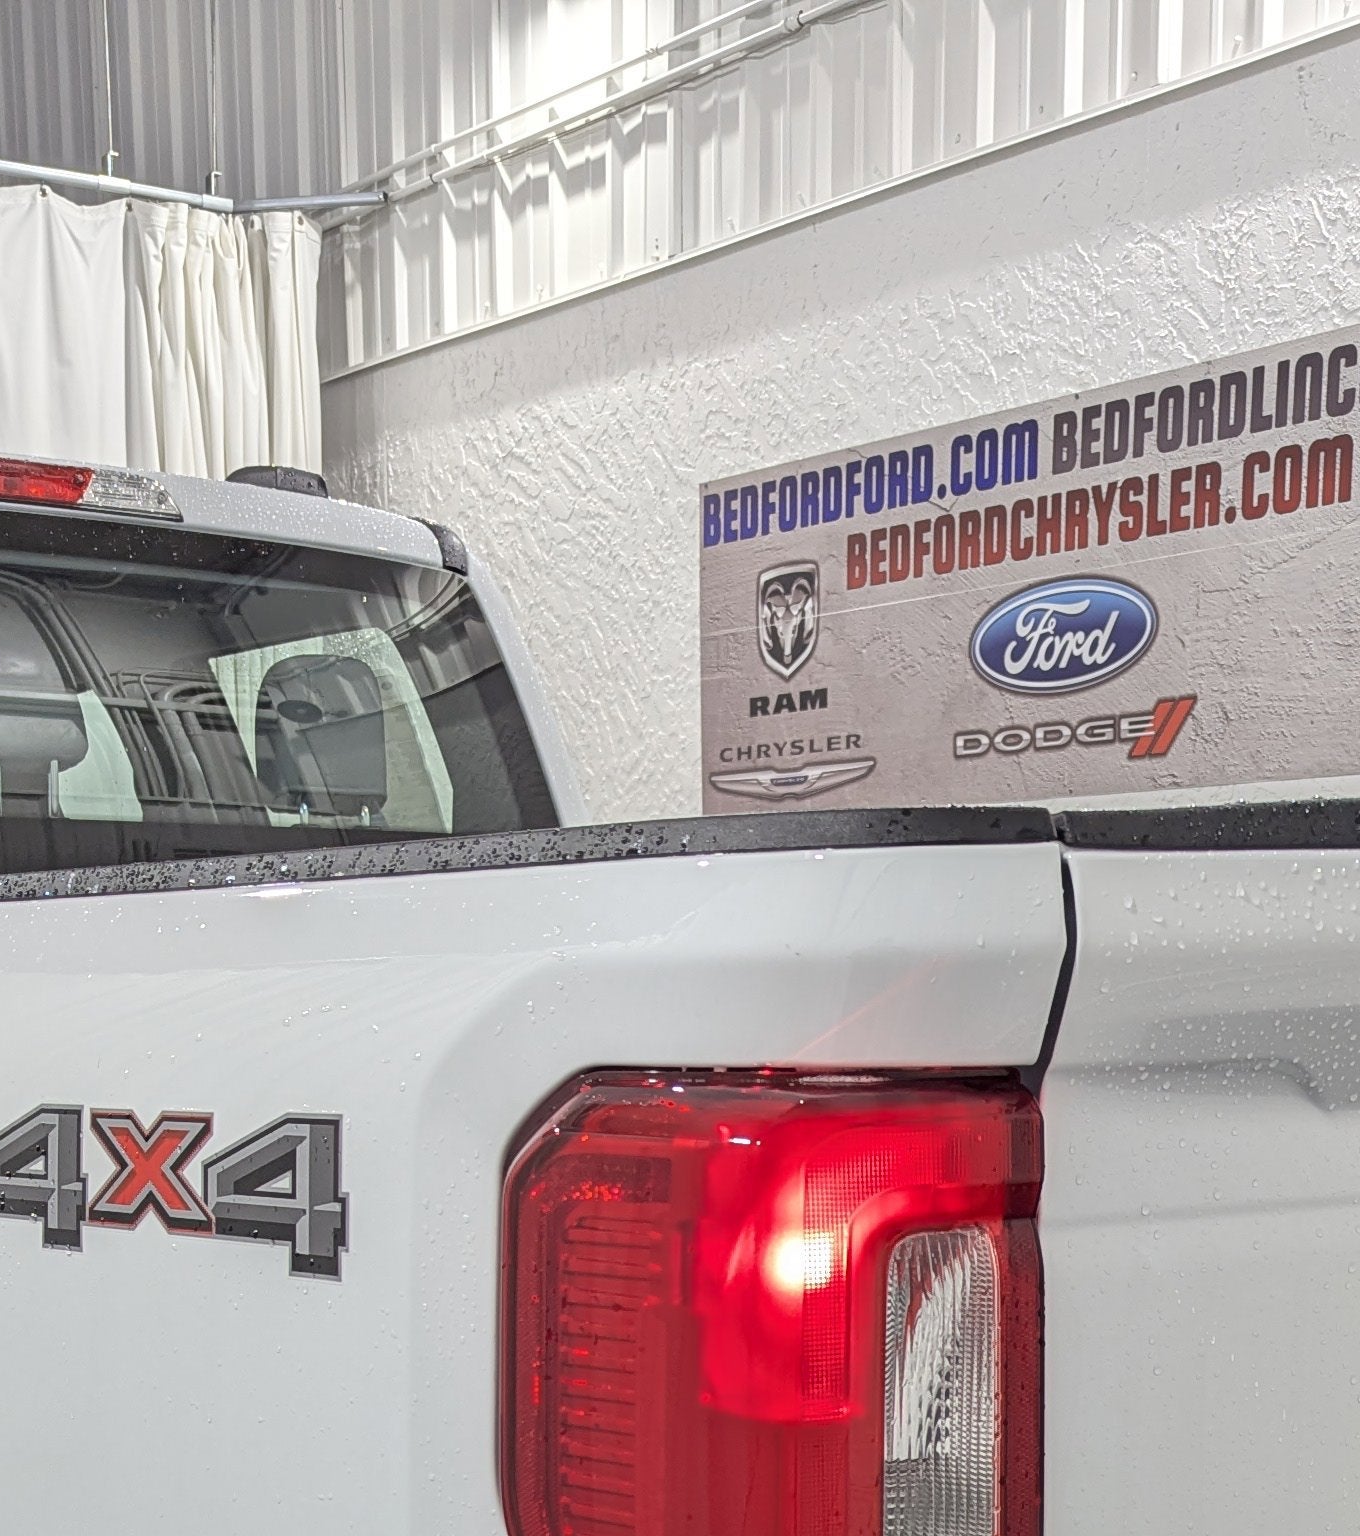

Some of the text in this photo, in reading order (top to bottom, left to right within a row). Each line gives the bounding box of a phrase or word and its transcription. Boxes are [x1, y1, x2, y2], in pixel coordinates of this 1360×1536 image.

[703, 419, 1039, 548] BEDFORDFORD.COM
[846, 433, 1354, 590] BEDFORDCHRYSLER.COM
[1004, 599, 1120, 675] Ford
[750, 688, 828, 717] RAM
[719, 734, 862, 763] CHRYSLER
[954, 714, 1157, 757] DODGE
